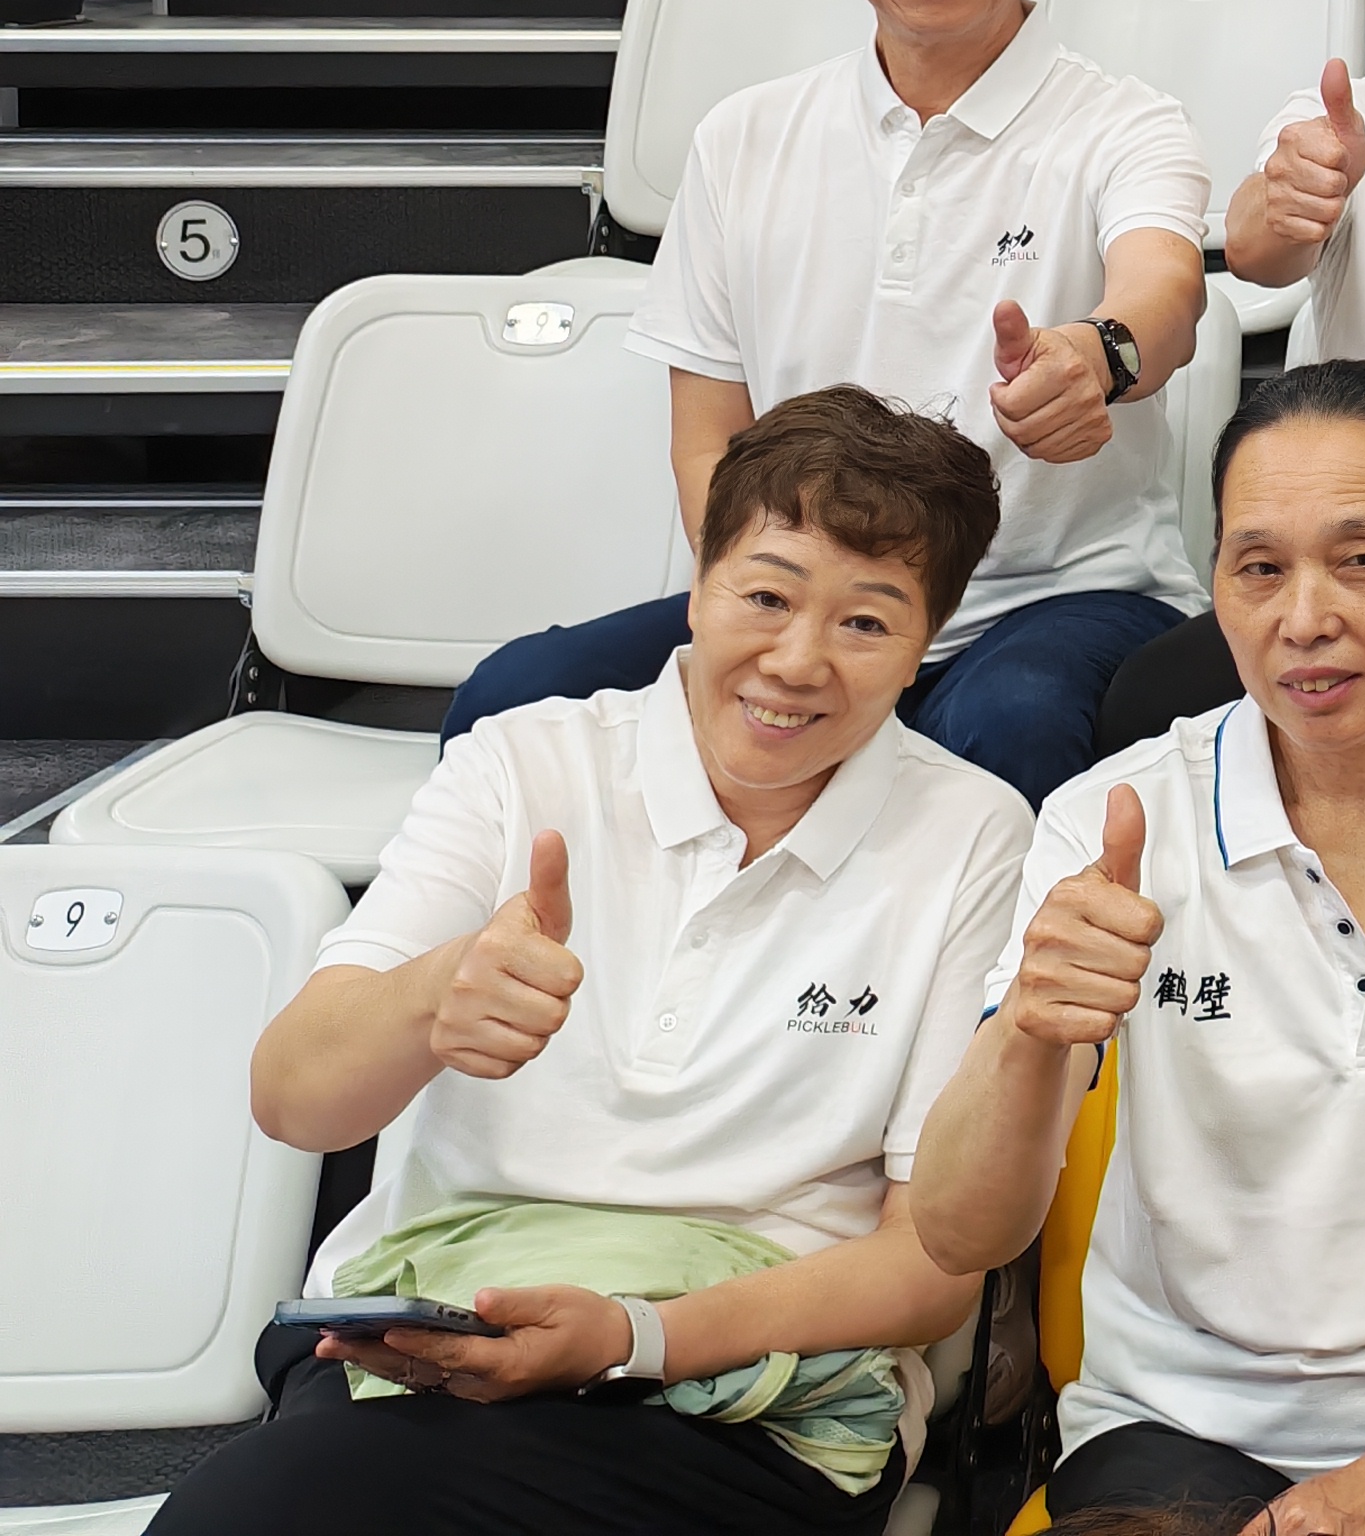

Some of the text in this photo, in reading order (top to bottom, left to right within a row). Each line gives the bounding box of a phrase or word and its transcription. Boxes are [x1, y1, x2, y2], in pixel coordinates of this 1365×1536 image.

[180, 219, 211, 262] 5
[537, 312, 549, 337] 9
[66, 901, 85, 938] 9
[798, 982, 879, 1018] 给力
[1153, 967, 1231, 1022] 鹤壁
[787, 1019, 879, 1036] PICKLEBULL
